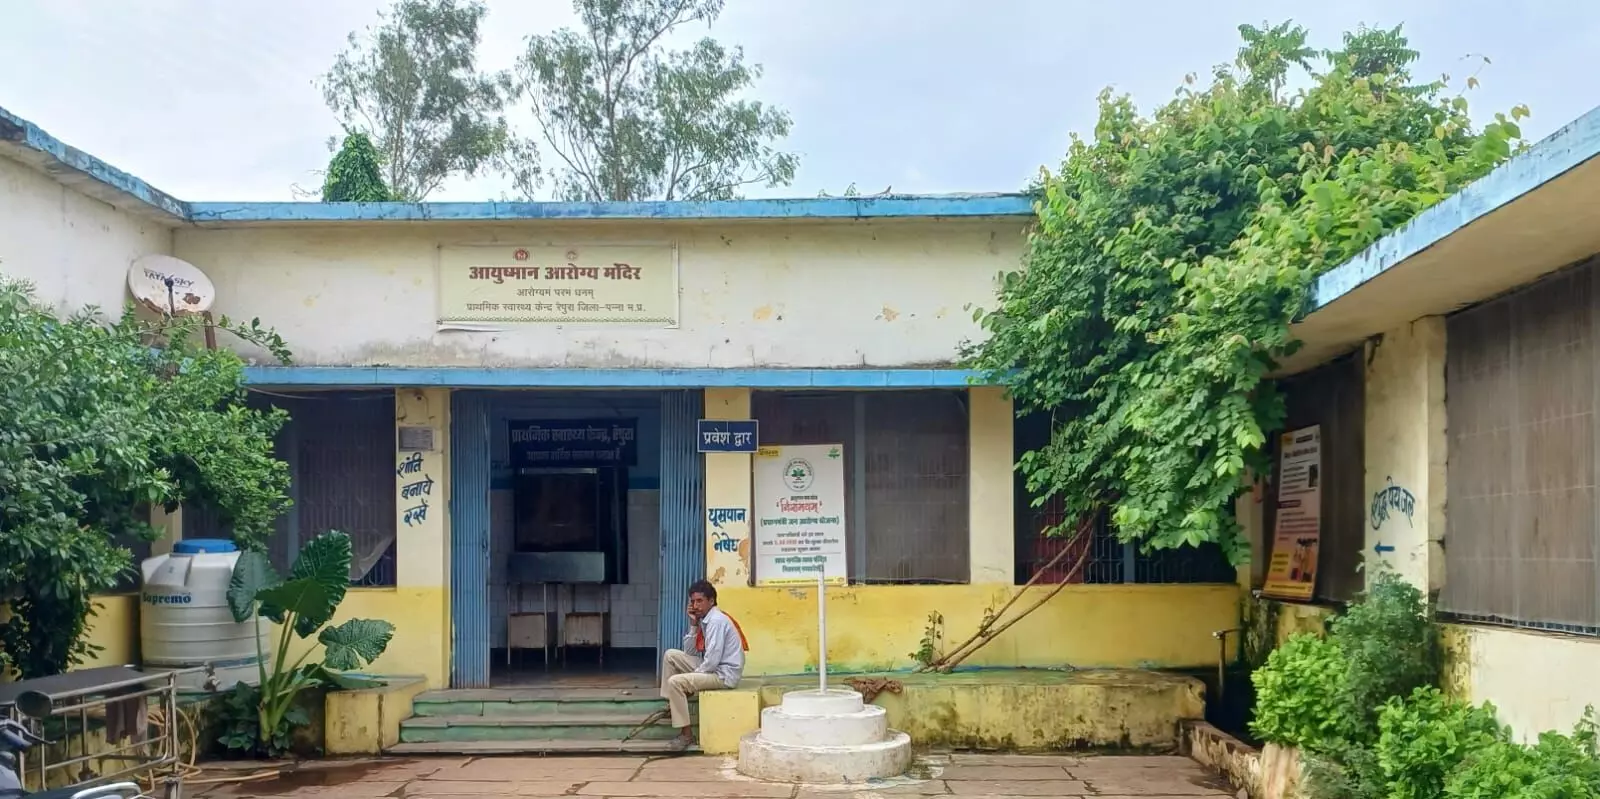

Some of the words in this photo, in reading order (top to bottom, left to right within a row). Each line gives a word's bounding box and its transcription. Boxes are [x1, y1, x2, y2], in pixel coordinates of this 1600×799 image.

[468, 265, 540, 284] आयुष्मान
[544, 263, 600, 280] आरोग्य
[603, 263, 642, 280] मंदिर
[466, 301, 499, 312] प्राथमिक
[502, 302, 532, 312] स्वास्थ्य
[703, 427, 731, 446] प्रवेश
[733, 431, 752, 447] द्वार
[397, 452, 424, 479] शांति
